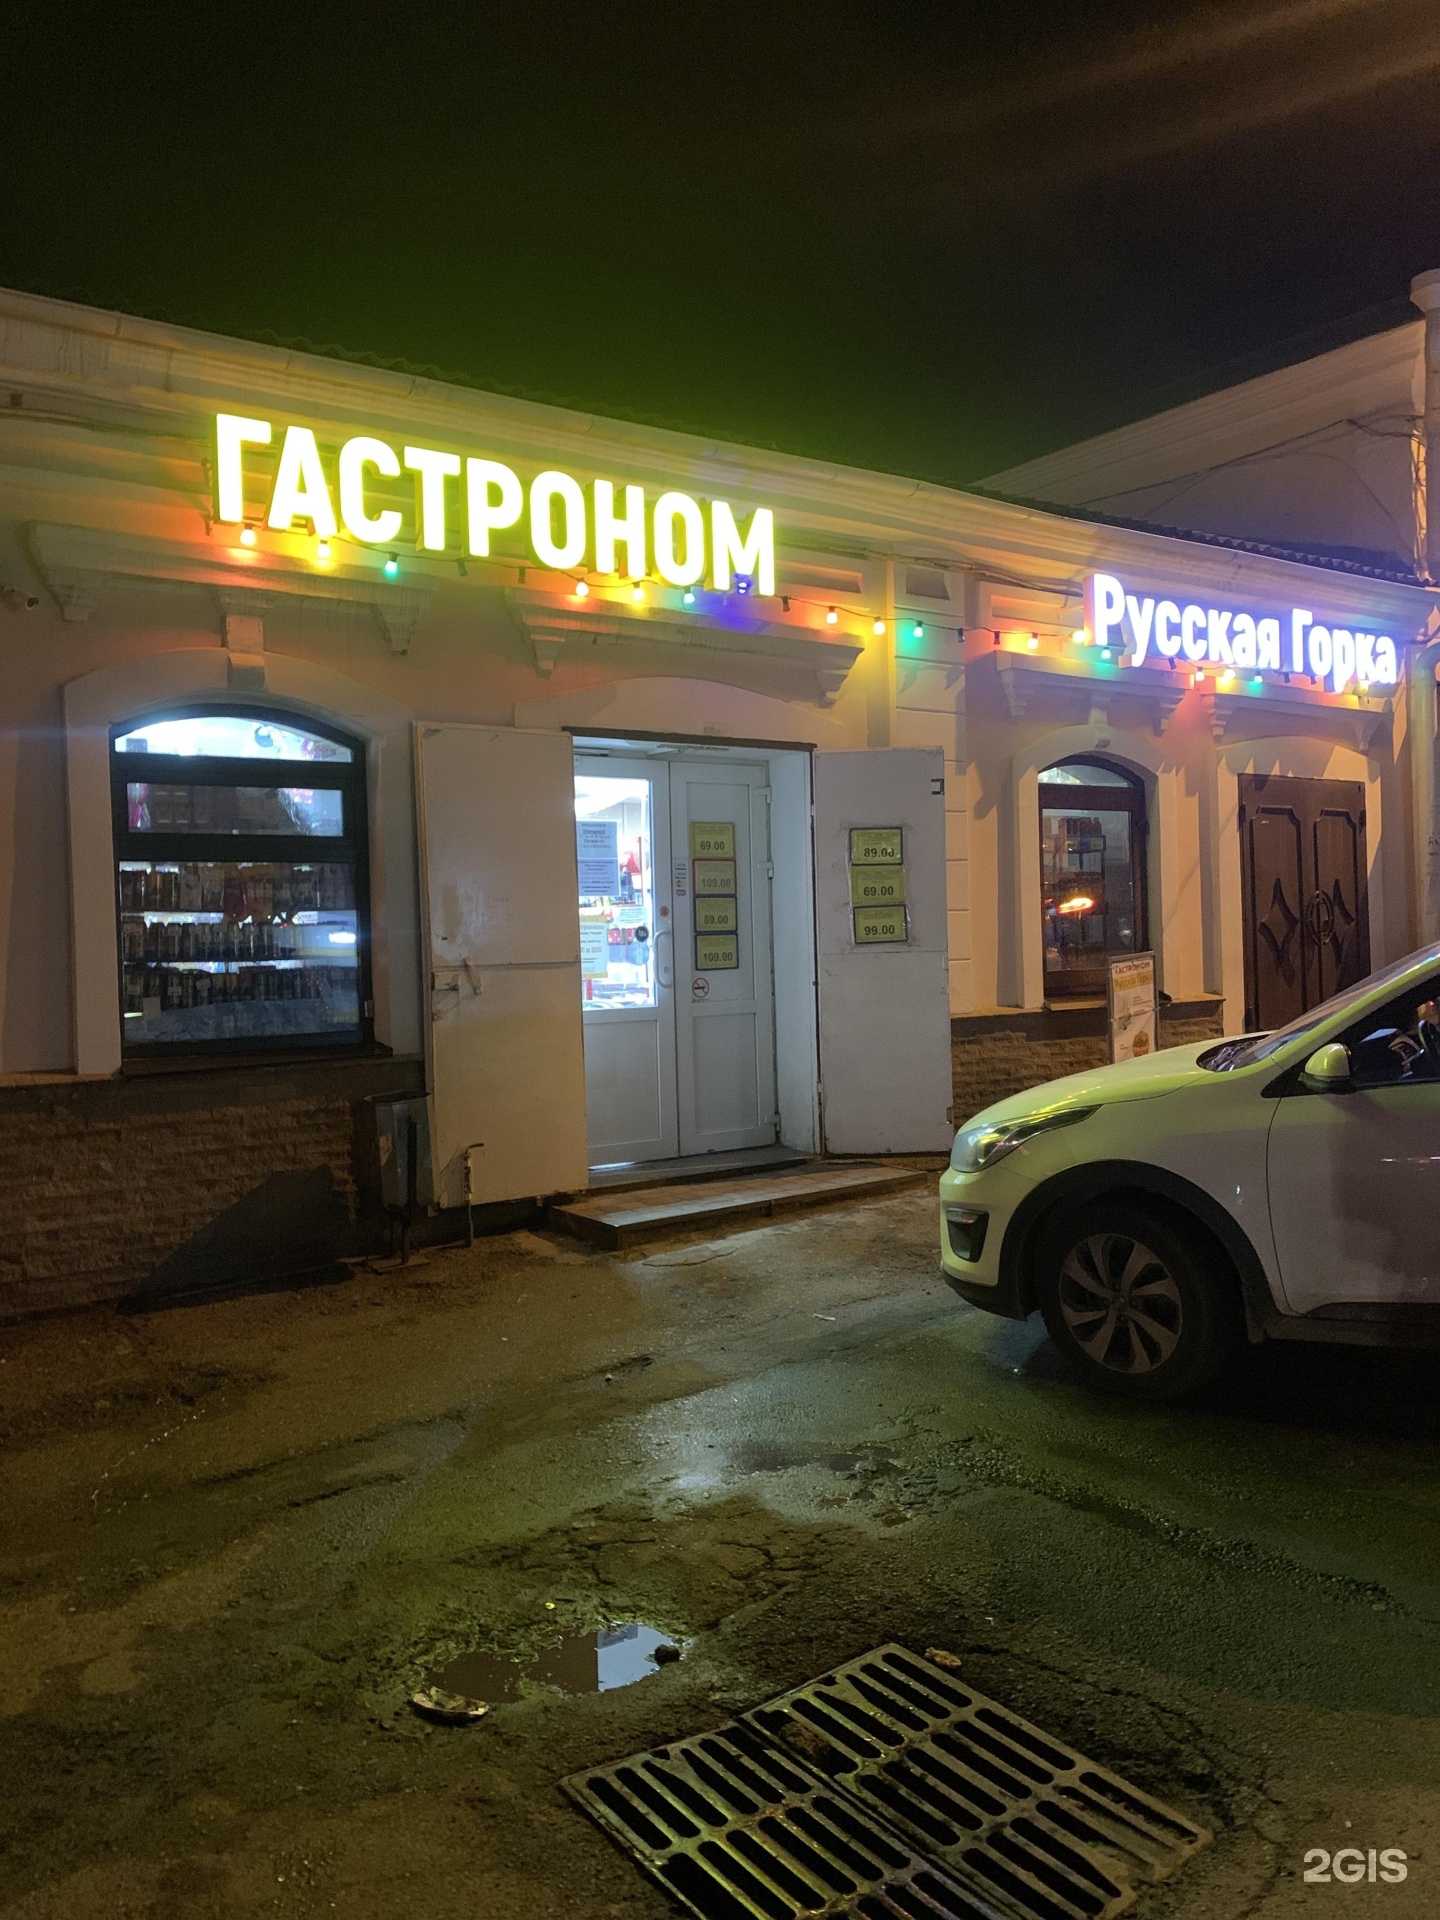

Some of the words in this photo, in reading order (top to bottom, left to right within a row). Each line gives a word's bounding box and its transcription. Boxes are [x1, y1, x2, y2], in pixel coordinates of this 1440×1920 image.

[214, 413, 776, 597] ГАСТРОНОМ
[1091, 572, 1281, 668] Русская
[1291, 607, 1398, 694] Горка
[863, 847, 895, 858] 89.00
[863, 886, 894, 897] 69.00
[864, 925, 895, 936] 99.00
